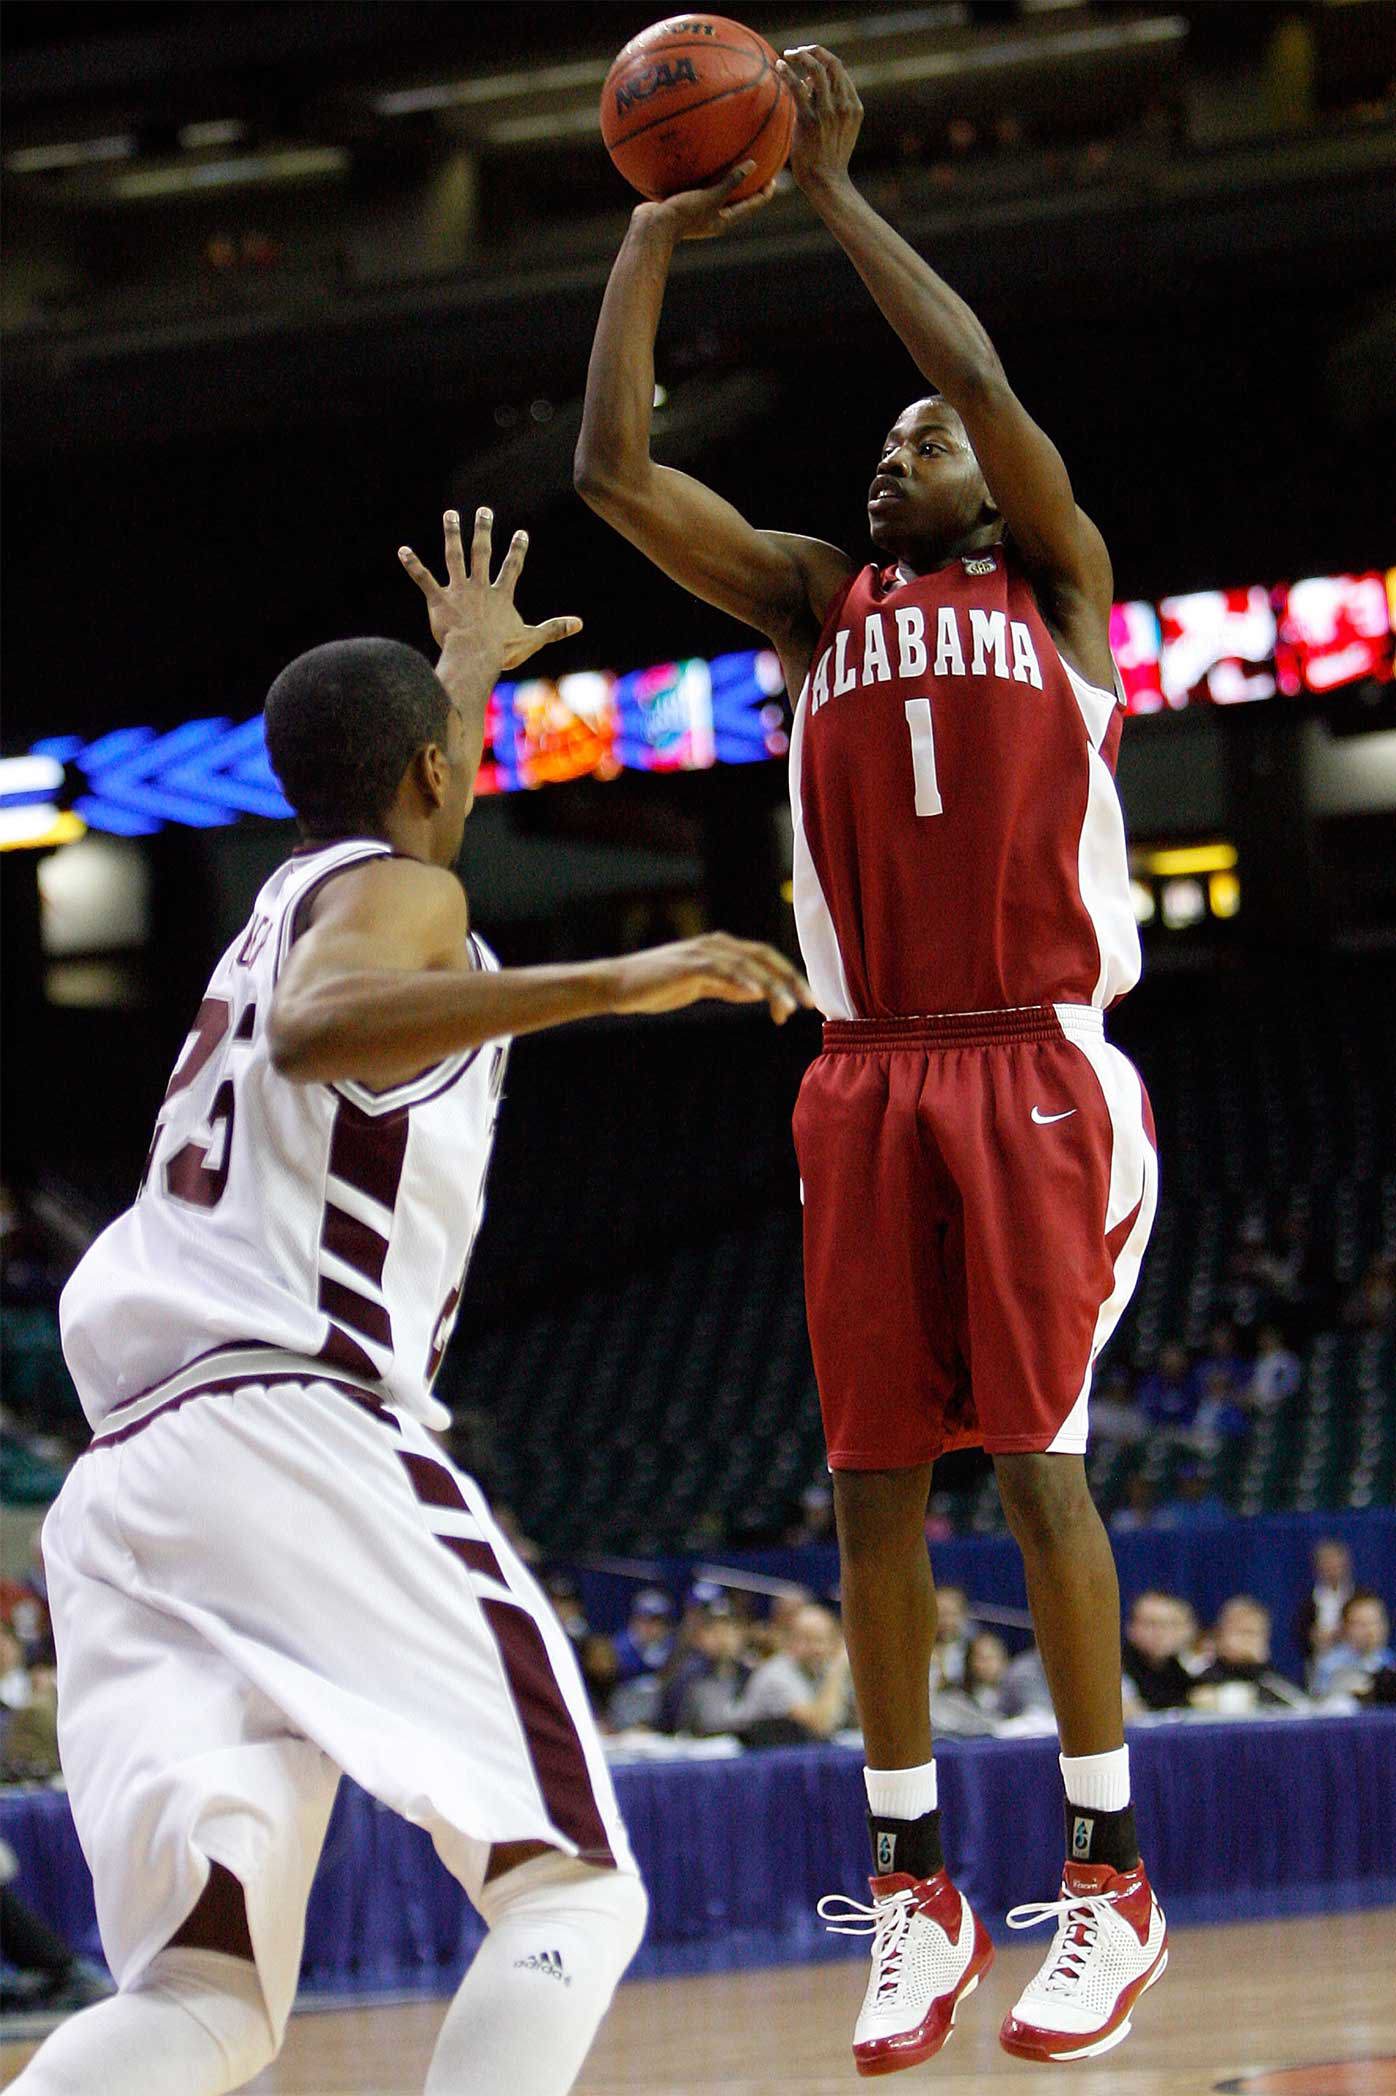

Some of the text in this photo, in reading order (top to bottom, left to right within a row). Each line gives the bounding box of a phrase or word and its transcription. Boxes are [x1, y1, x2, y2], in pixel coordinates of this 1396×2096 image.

[616, 57, 698, 116] NCAA
[811, 606, 1043, 716] ALABAMA
[904, 697, 943, 817] 1
